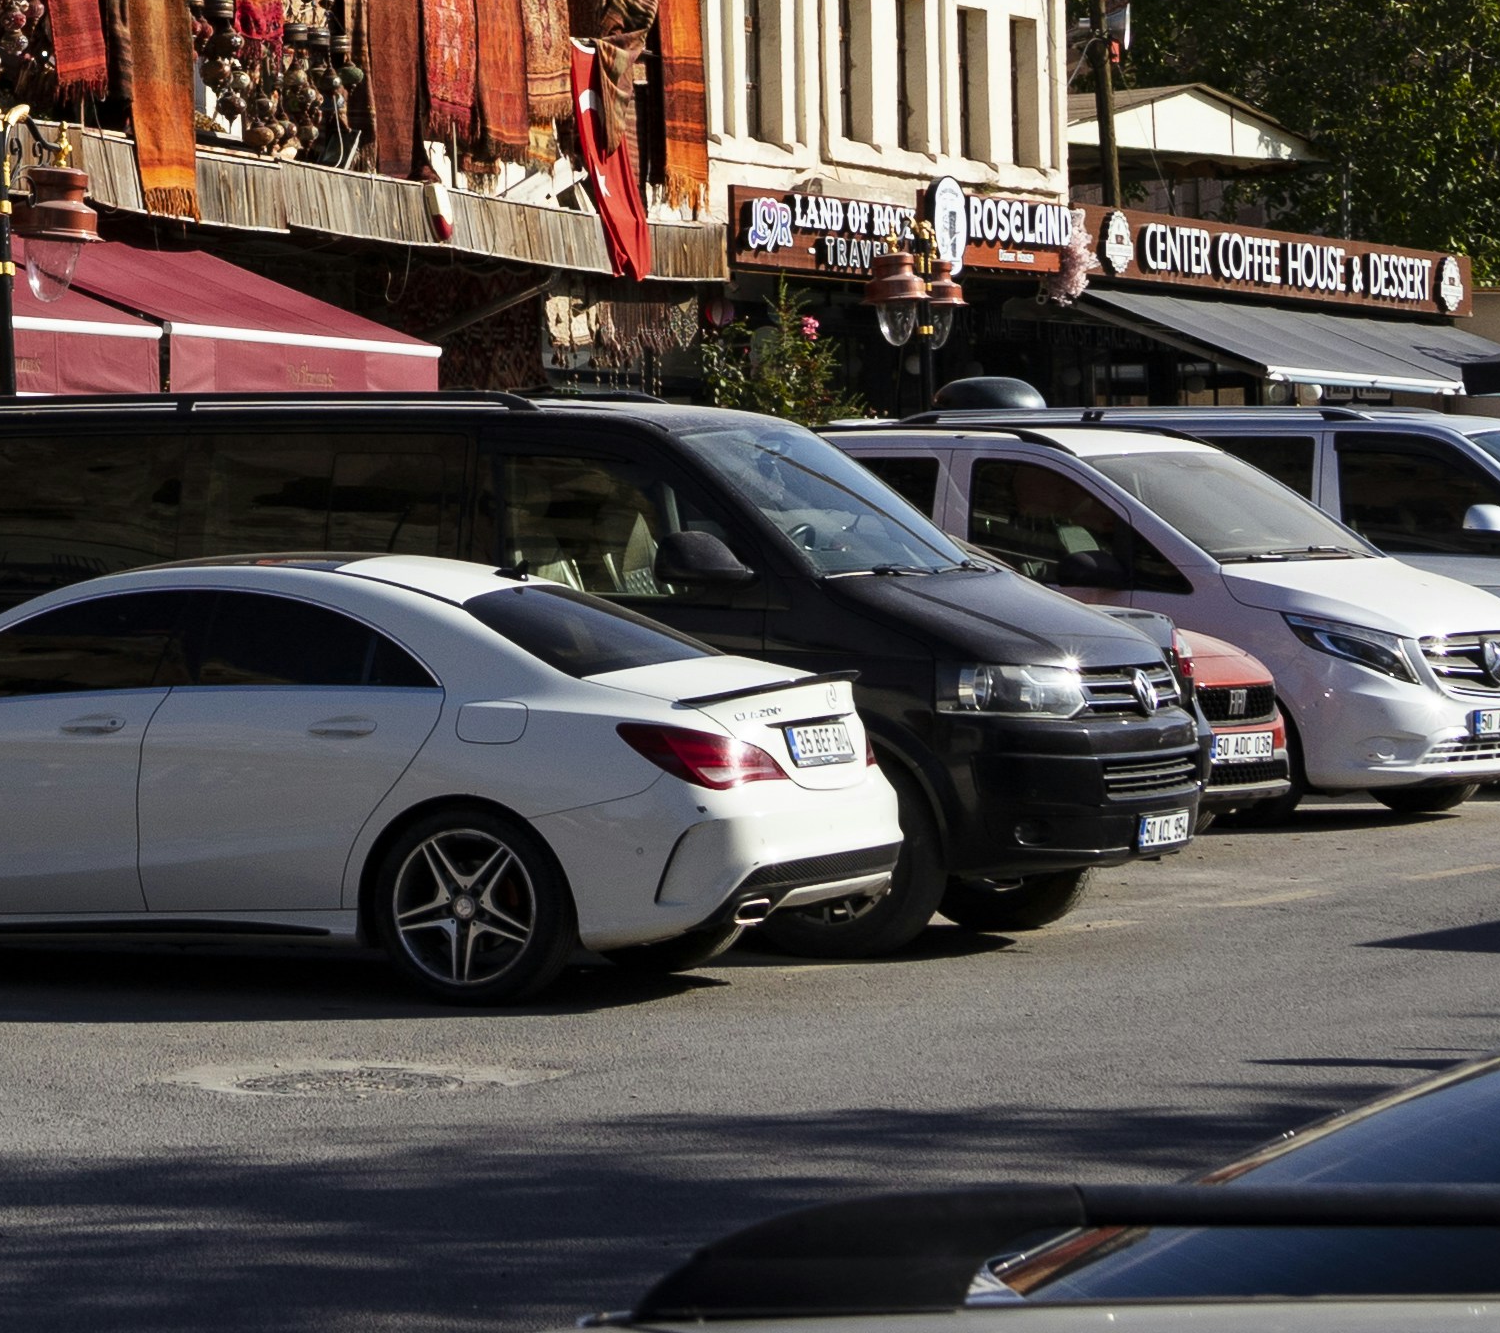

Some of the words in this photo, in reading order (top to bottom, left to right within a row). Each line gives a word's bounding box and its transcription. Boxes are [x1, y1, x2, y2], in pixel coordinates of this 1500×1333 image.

[794, 194, 844, 232] LAND
[847, 201, 871, 234] OF
[970, 196, 1072, 247] ROSELAND
[1145, 222, 1212, 275] CENTER
[1217, 233, 1281, 284] COFFEE
[1287, 242, 1346, 290] HOUSE
[1352, 256, 1363, 293] &
[1369, 253, 1432, 301] DESSERT
[1482, 713, 1493, 731] 50
[797, 729, 814, 755] 35
[812, 727, 831, 753] BEF
[1217, 737, 1230, 757] 50
[1234, 735, 1252, 755] ADC
[1145, 820, 1157, 844] 50
